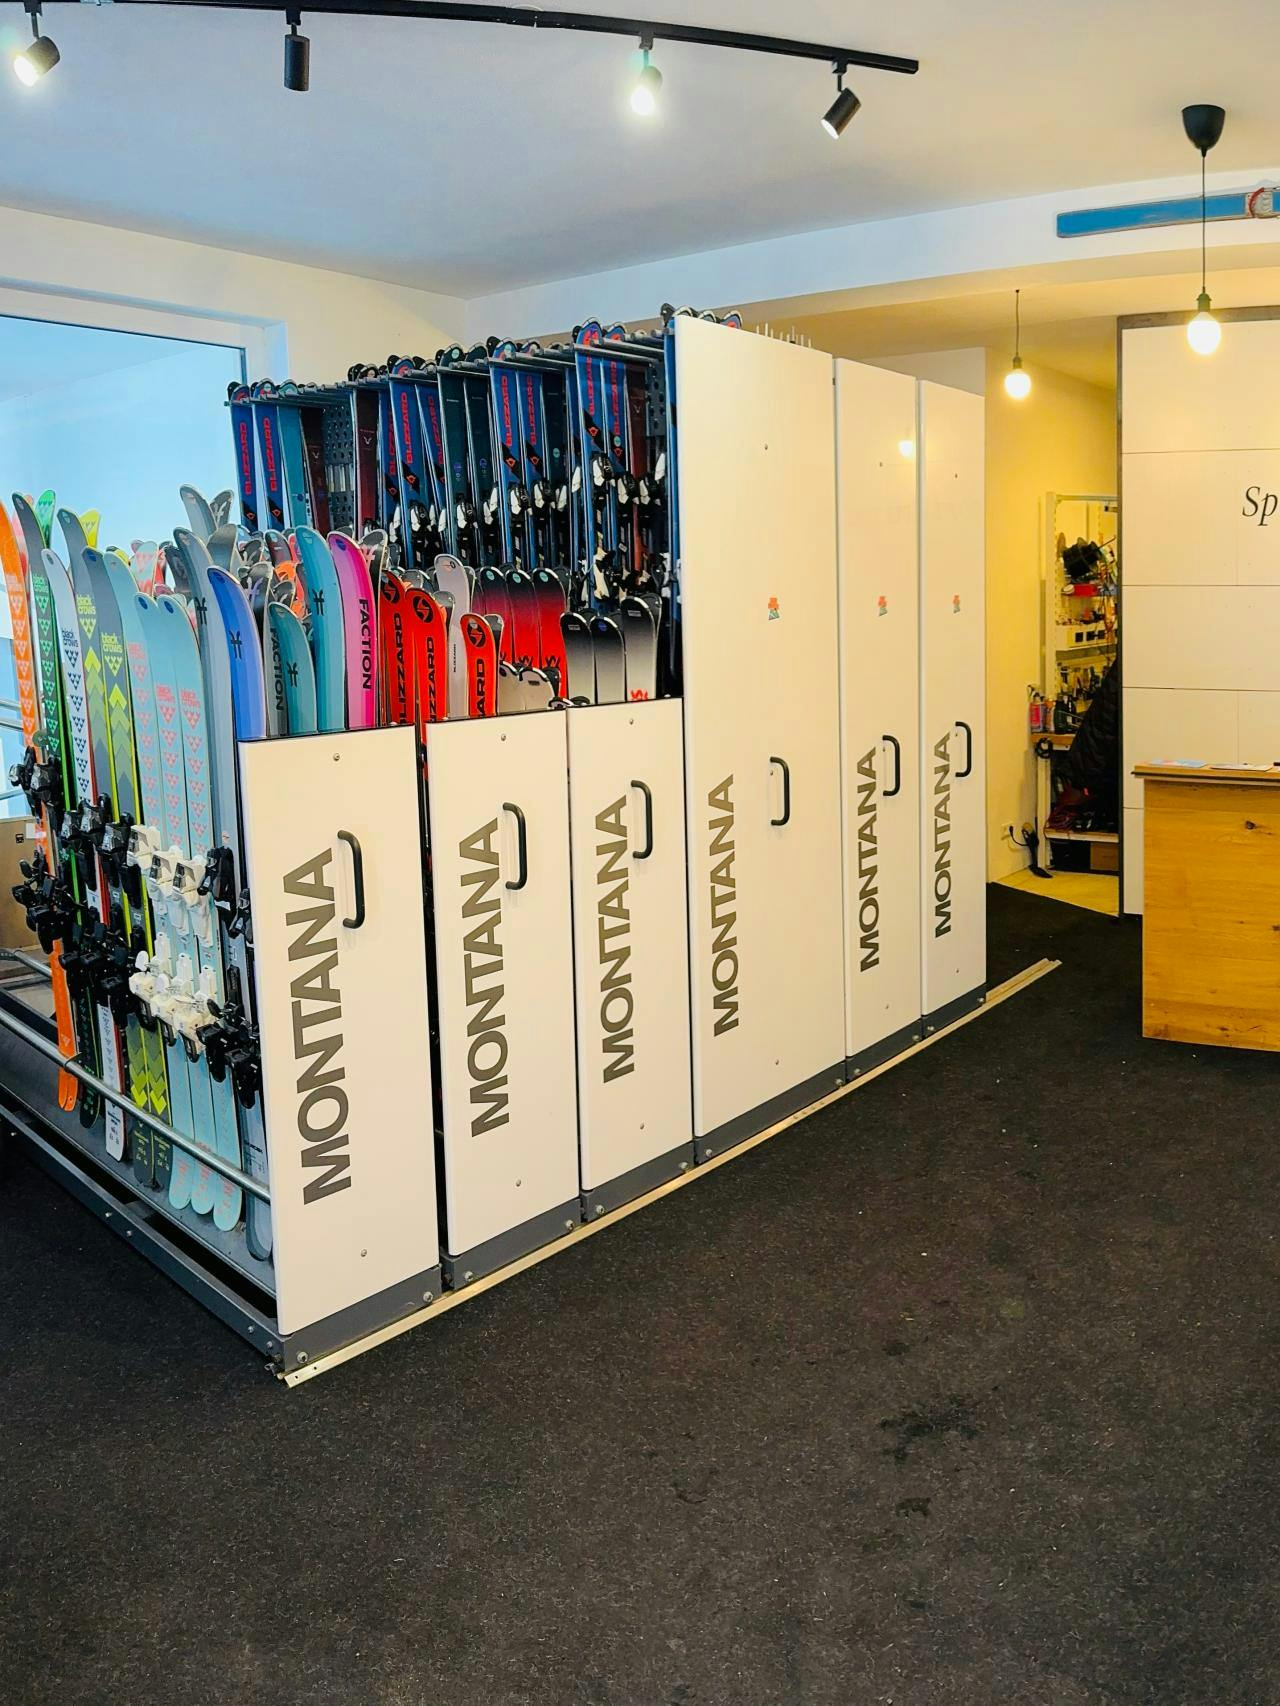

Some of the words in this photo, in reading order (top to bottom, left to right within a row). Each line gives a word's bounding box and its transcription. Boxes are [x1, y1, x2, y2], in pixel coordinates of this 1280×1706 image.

[77, 595, 92, 605] black
[78, 605, 96, 614] crows
[101, 633, 118, 644] black
[102, 643, 122, 653] crows
[271, 628, 284, 711] FACTION
[359, 599, 372, 689] FACTION
[708, 774, 739, 1037] MONTANA
[857, 746, 880, 972] MONTANA
[934, 733, 952, 938] MONTANA
[459, 817, 510, 1137] MONTANA
[595, 795, 635, 1083] MONTANA
[283, 848, 352, 1205] MONTANA
